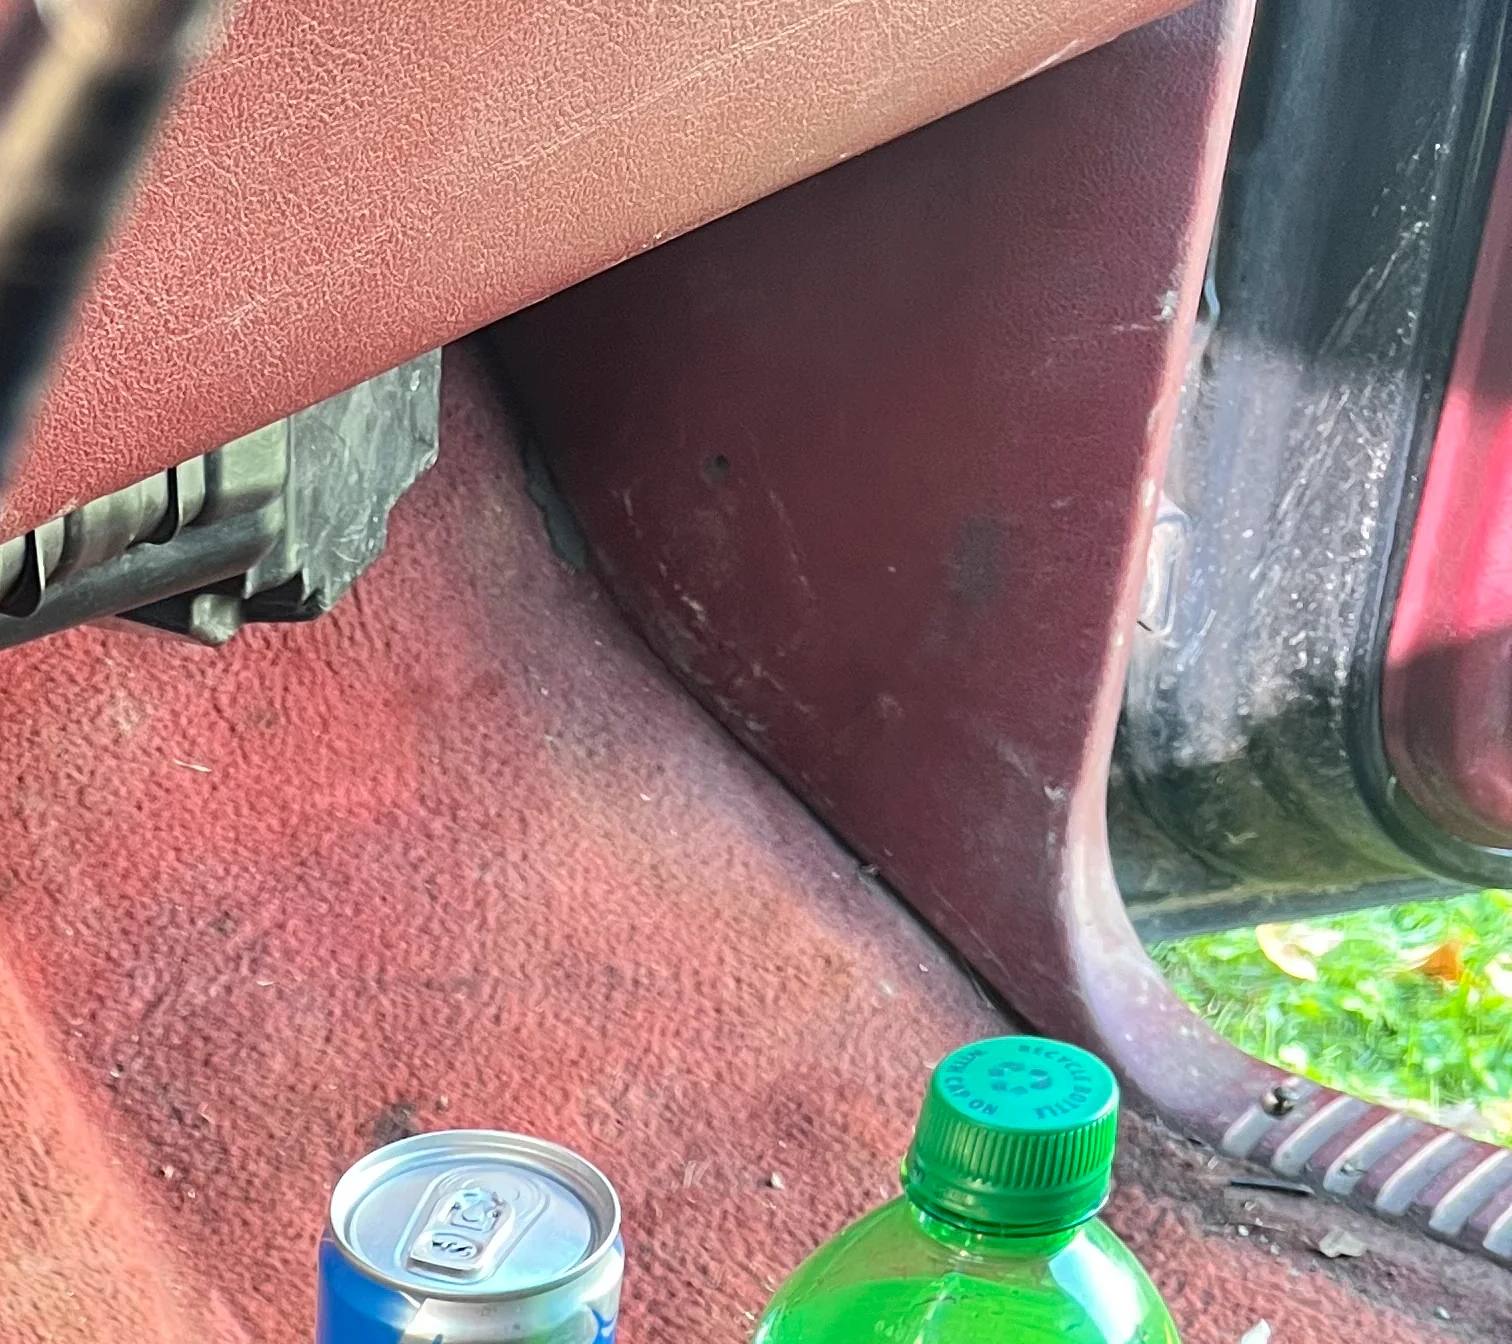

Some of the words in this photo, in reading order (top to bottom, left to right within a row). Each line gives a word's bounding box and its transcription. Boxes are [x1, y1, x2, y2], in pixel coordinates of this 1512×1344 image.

[1018, 1045, 1092, 1081] RECYCLE
[944, 1077, 972, 1098] CAP
[968, 1099, 999, 1115] ON
[1034, 1086, 1092, 1119] BOTTLE
